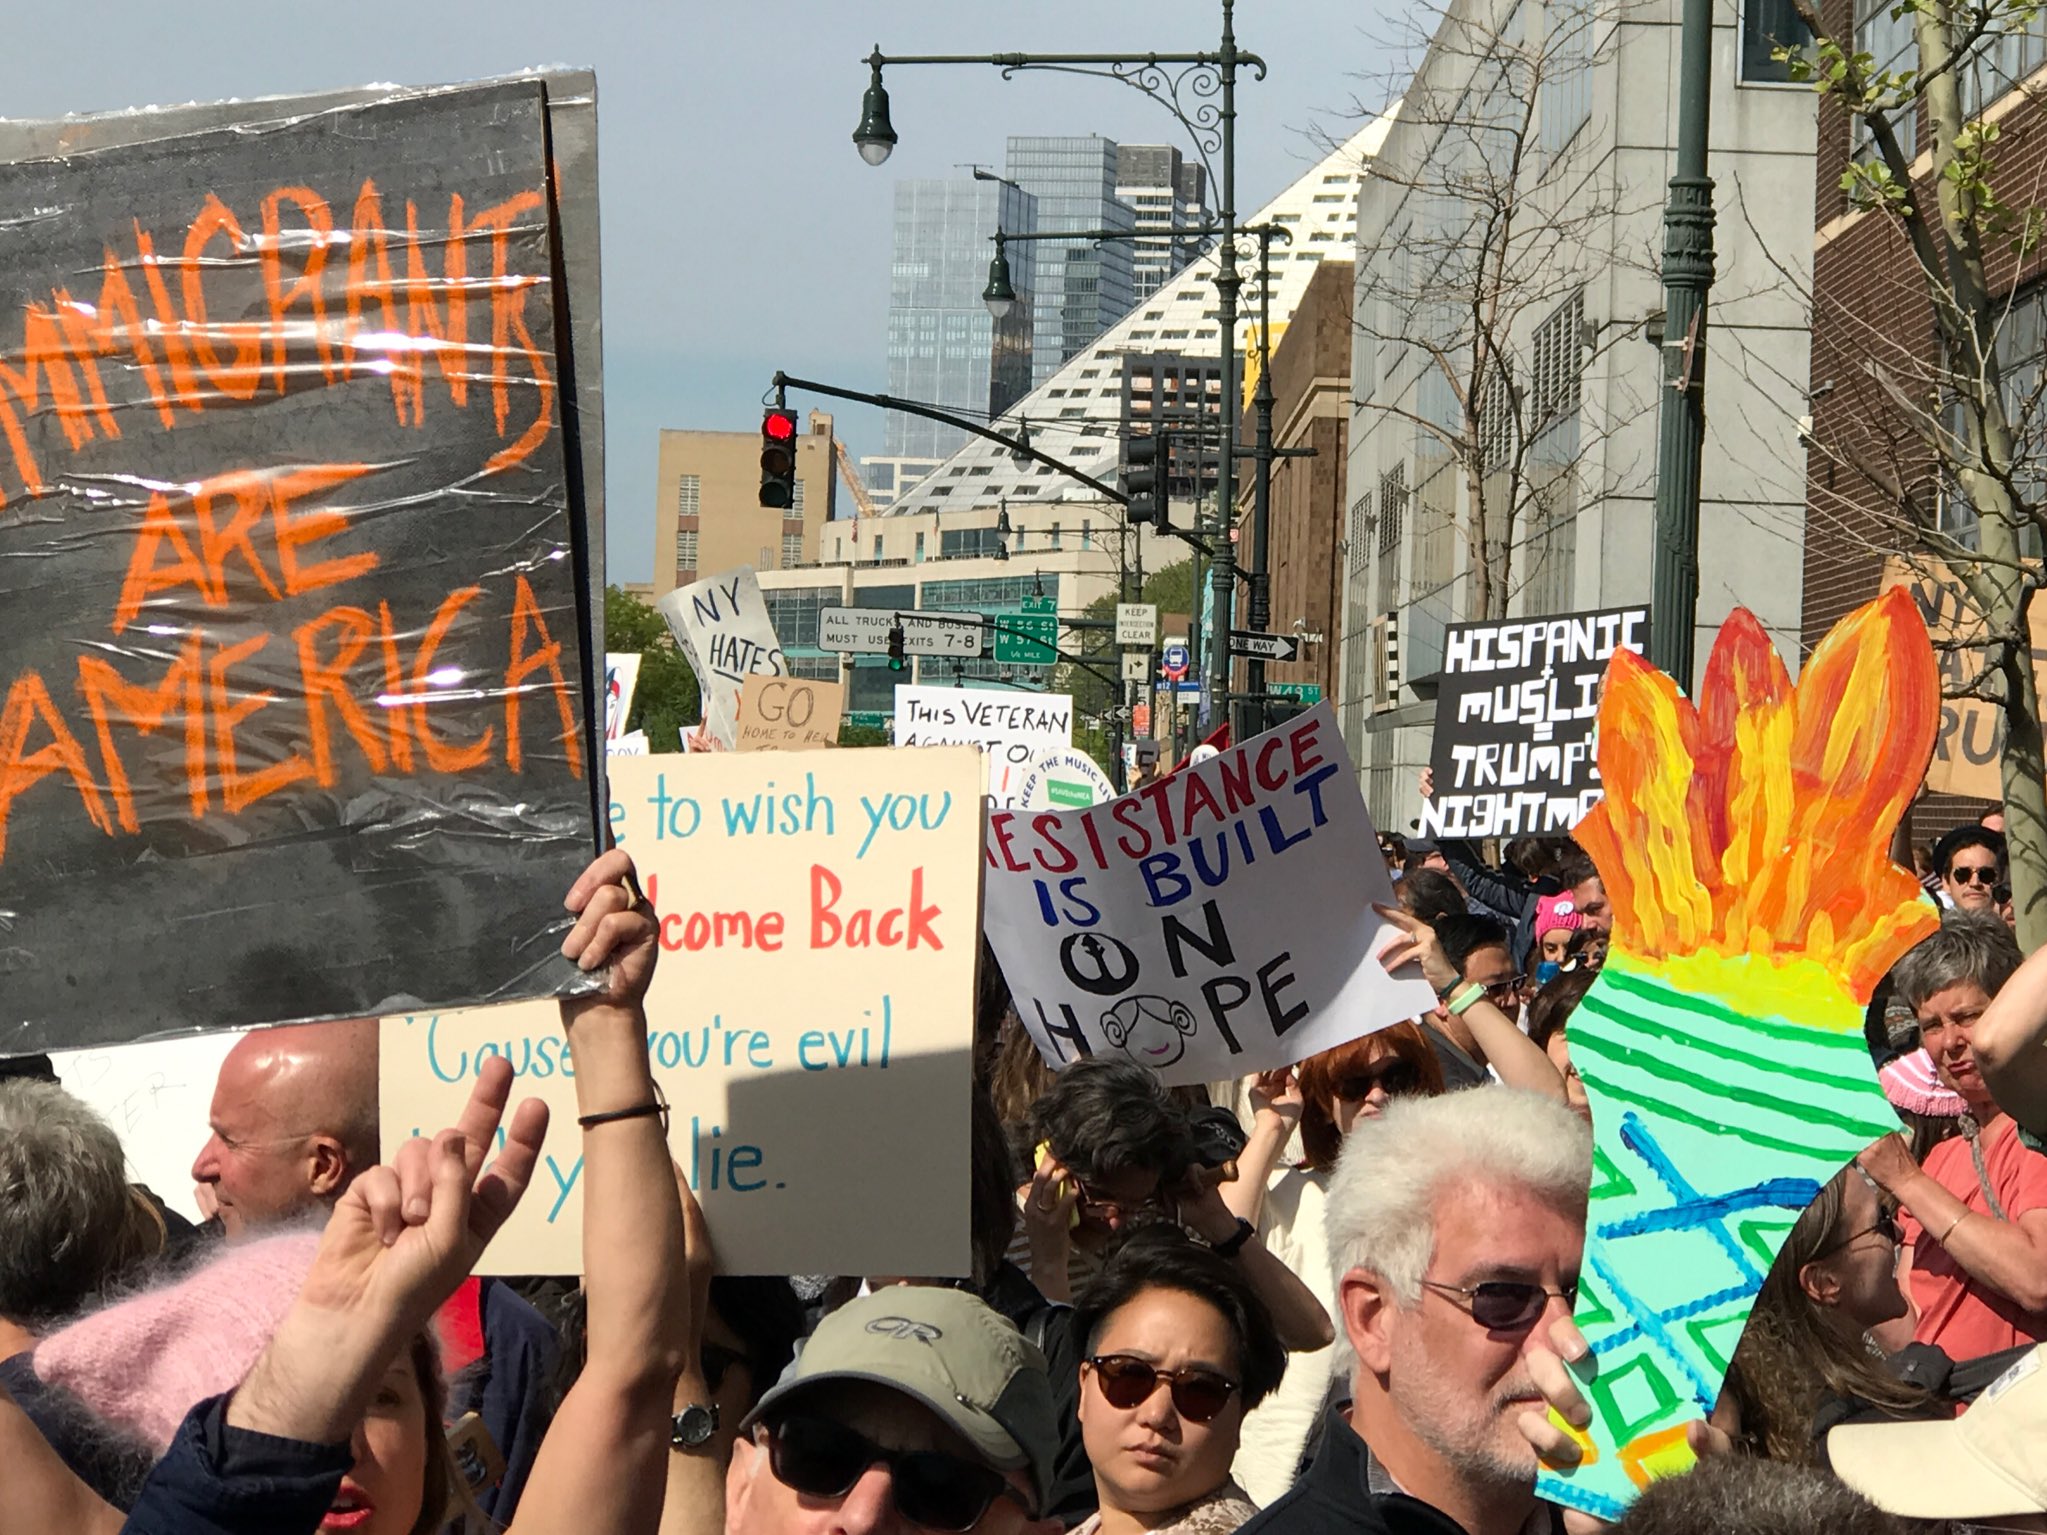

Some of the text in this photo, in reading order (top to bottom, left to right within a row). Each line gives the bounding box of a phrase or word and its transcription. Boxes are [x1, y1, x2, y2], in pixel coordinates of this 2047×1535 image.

[0, 178, 552, 508] MMIGRANTS
[113, 462, 380, 634] ARE
[692, 577, 740, 628] NY
[826, 615, 849, 626] ALL
[908, 617, 933, 629] AND
[999, 619, 1010, 630] W
[1022, 599, 1057, 612] EXIT 7
[1125, 608, 1148, 617] KEEP
[709, 633, 783, 678] HATES
[826, 634, 858, 644] MUST
[868, 635, 890, 645] USE
[944, 634, 975, 649] 7-8
[999, 634, 1010, 645] W
[1024, 651, 1041, 659] MILE
[1122, 630, 1151, 639] CLEAR
[1229, 637, 1275, 652] ONE WAY
[1445, 610, 1646, 674] HISPANIC
[0, 573, 582, 866] AMERICA
[758, 682, 814, 728] GO
[907, 699, 957, 725] THIS
[961, 699, 1069, 733] VETERAN
[1458, 673, 1600, 725] MUSLI
[742, 727, 777, 740] HOME
[1021, 773, 1037, 808] KEEP
[1039, 756, 1059, 773] THE
[1065, 755, 1098, 782] MUSIC
[647, 773, 702, 841] to
[722, 771, 835, 838] wish
[857, 789, 953, 860] you
[1417, 788, 1606, 839] NIGHTMA
[1033, 762, 1339, 927] IS BUILT
[647, 863, 945, 952] come Back
[799, 995, 893, 1072] evil
[691, 1116, 787, 1192] lie.
